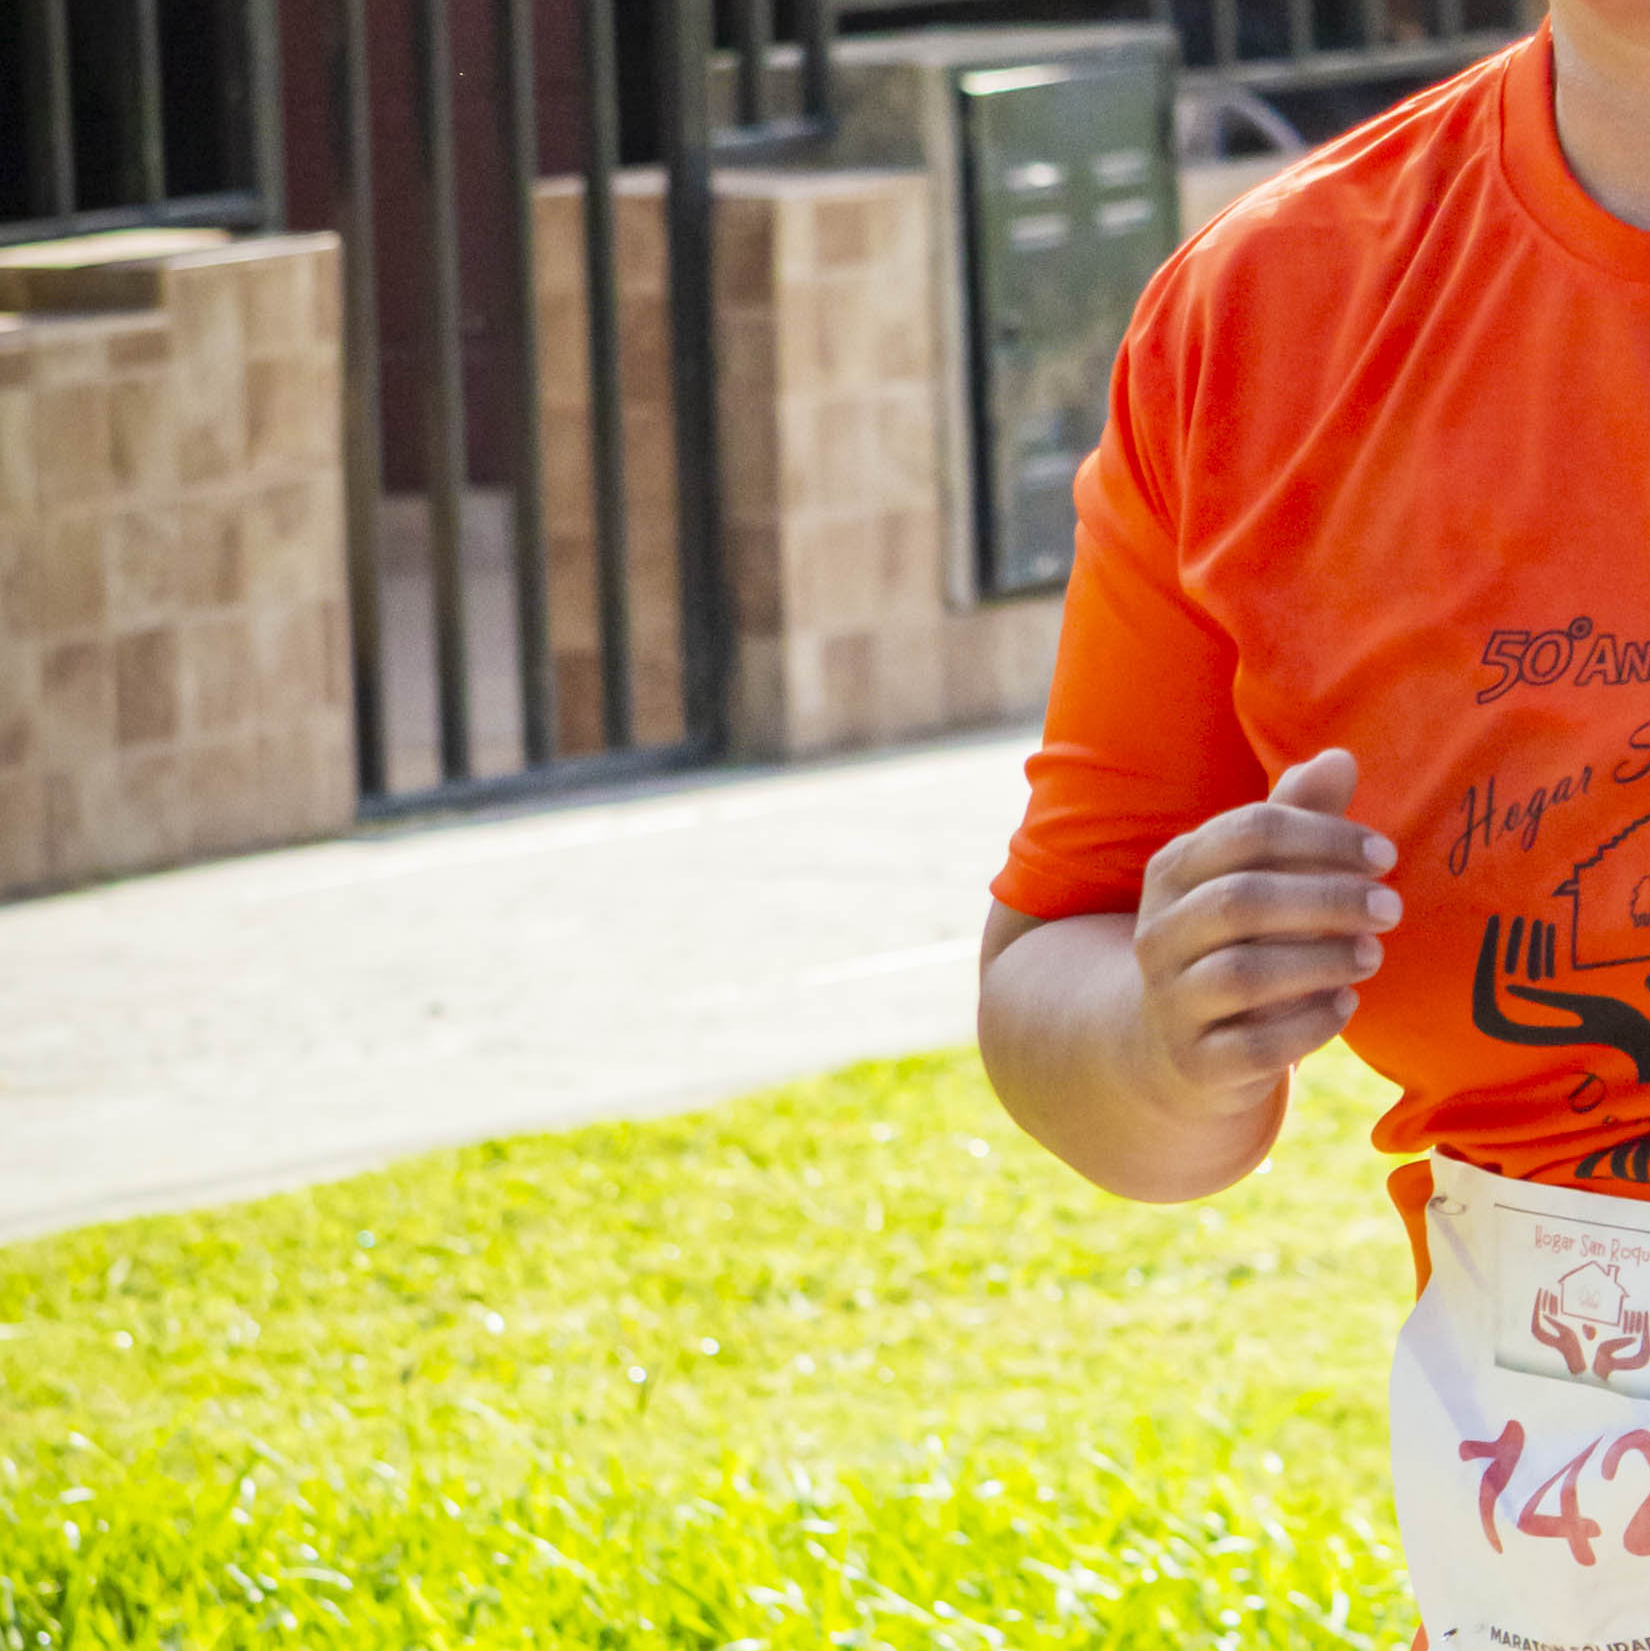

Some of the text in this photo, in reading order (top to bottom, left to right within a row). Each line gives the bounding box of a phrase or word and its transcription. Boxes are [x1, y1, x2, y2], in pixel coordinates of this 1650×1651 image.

[1449, 766, 1592, 876] Hogar
[1535, 1225, 1576, 1254] Hogar
[1580, 1234, 1606, 1258] San
